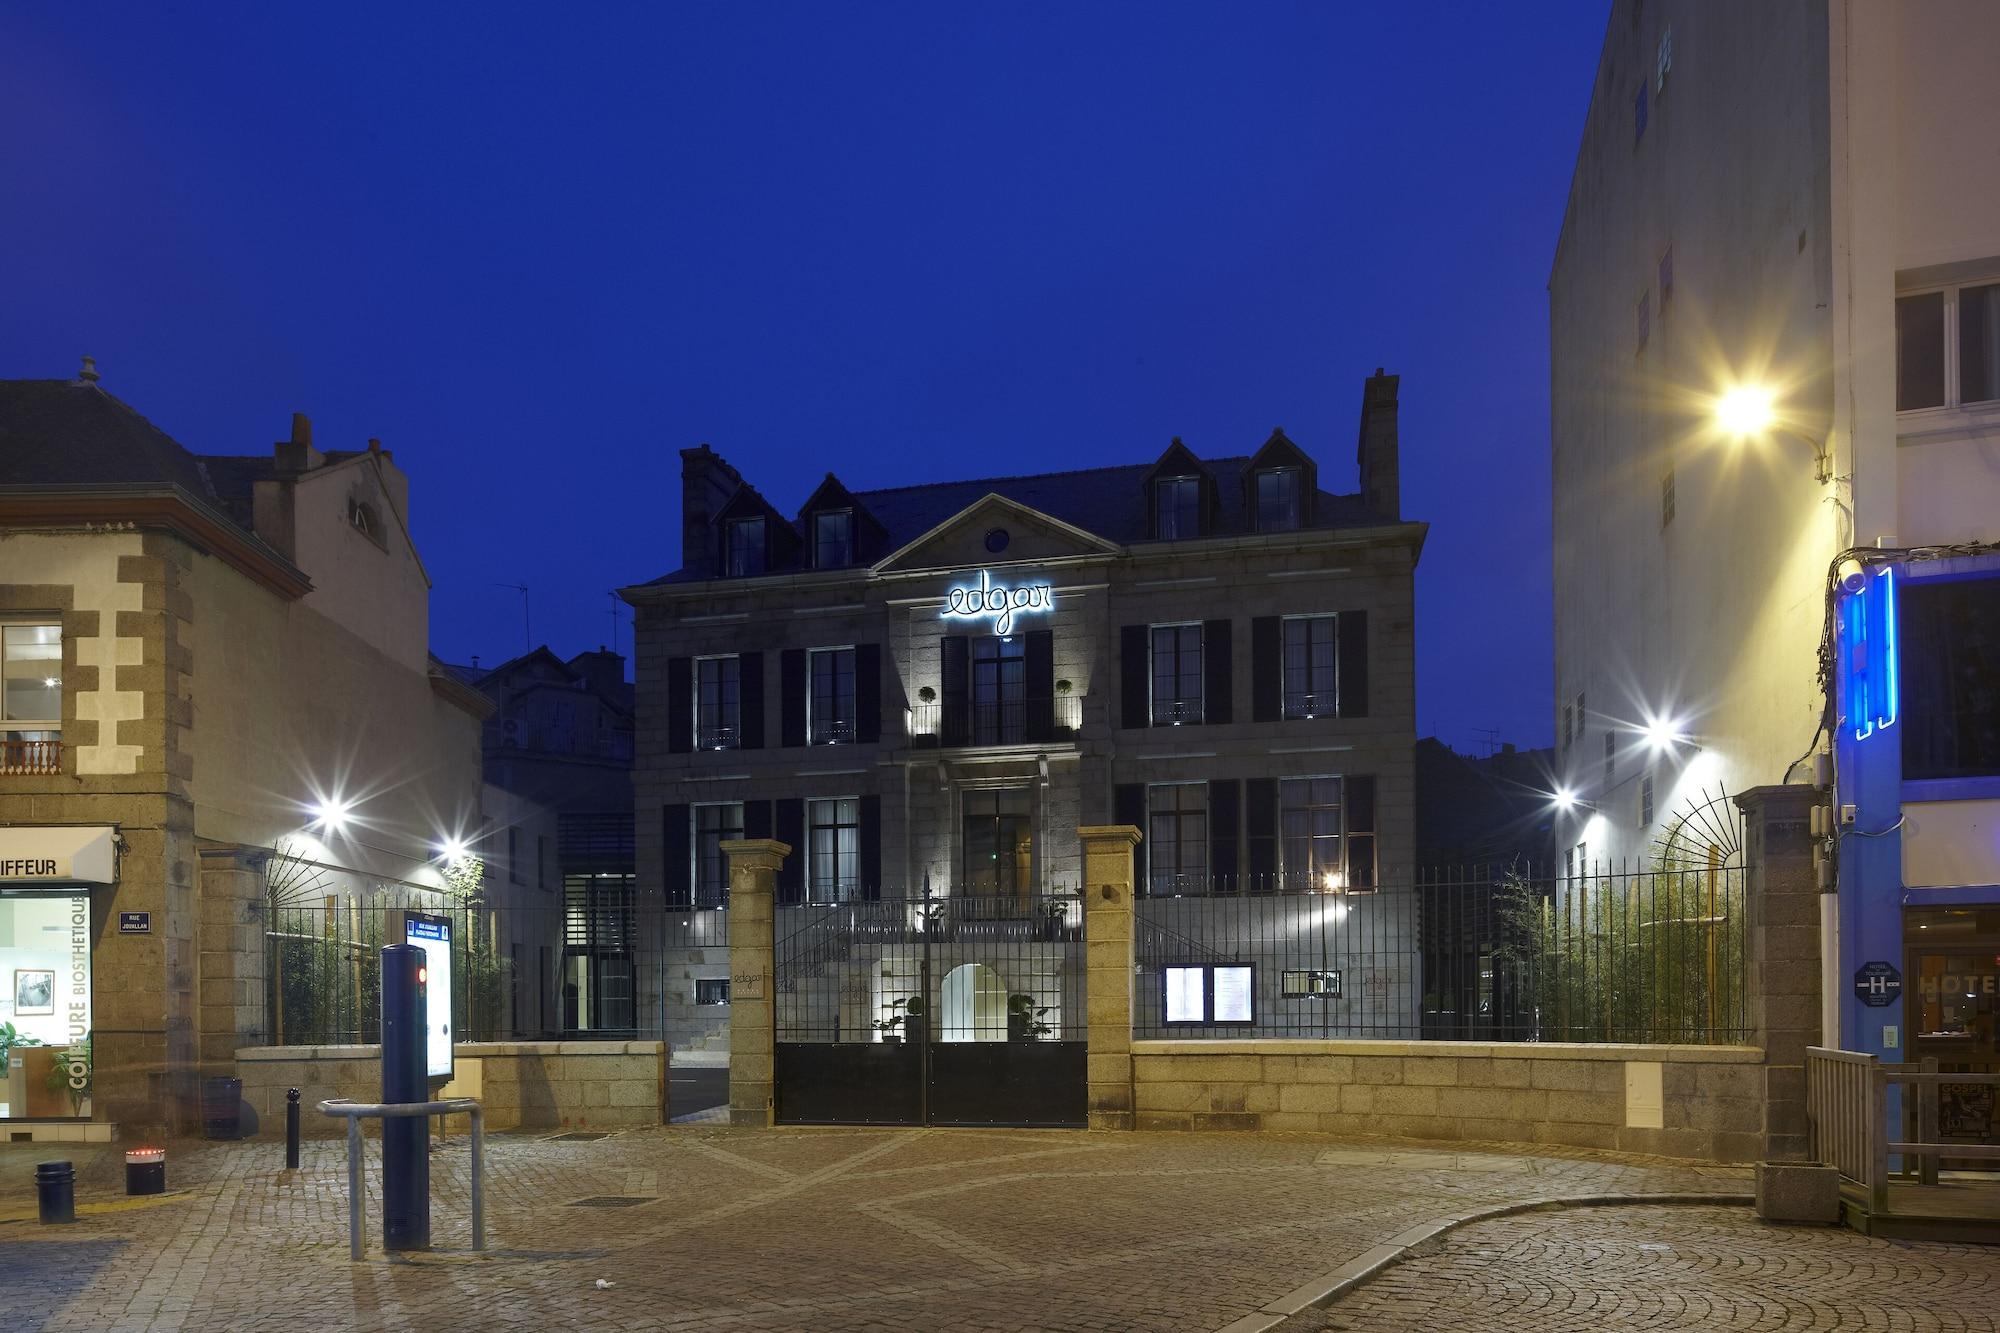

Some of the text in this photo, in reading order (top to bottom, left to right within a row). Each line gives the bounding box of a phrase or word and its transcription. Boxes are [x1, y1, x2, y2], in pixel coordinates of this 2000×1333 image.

[941, 569, 1053, 634] edgar
[0, 860, 56, 875] IFFEUR
[734, 970, 761, 989] edgar
[1870, 976, 1885, 993] H
[1920, 976, 2000, 993] HOTE
